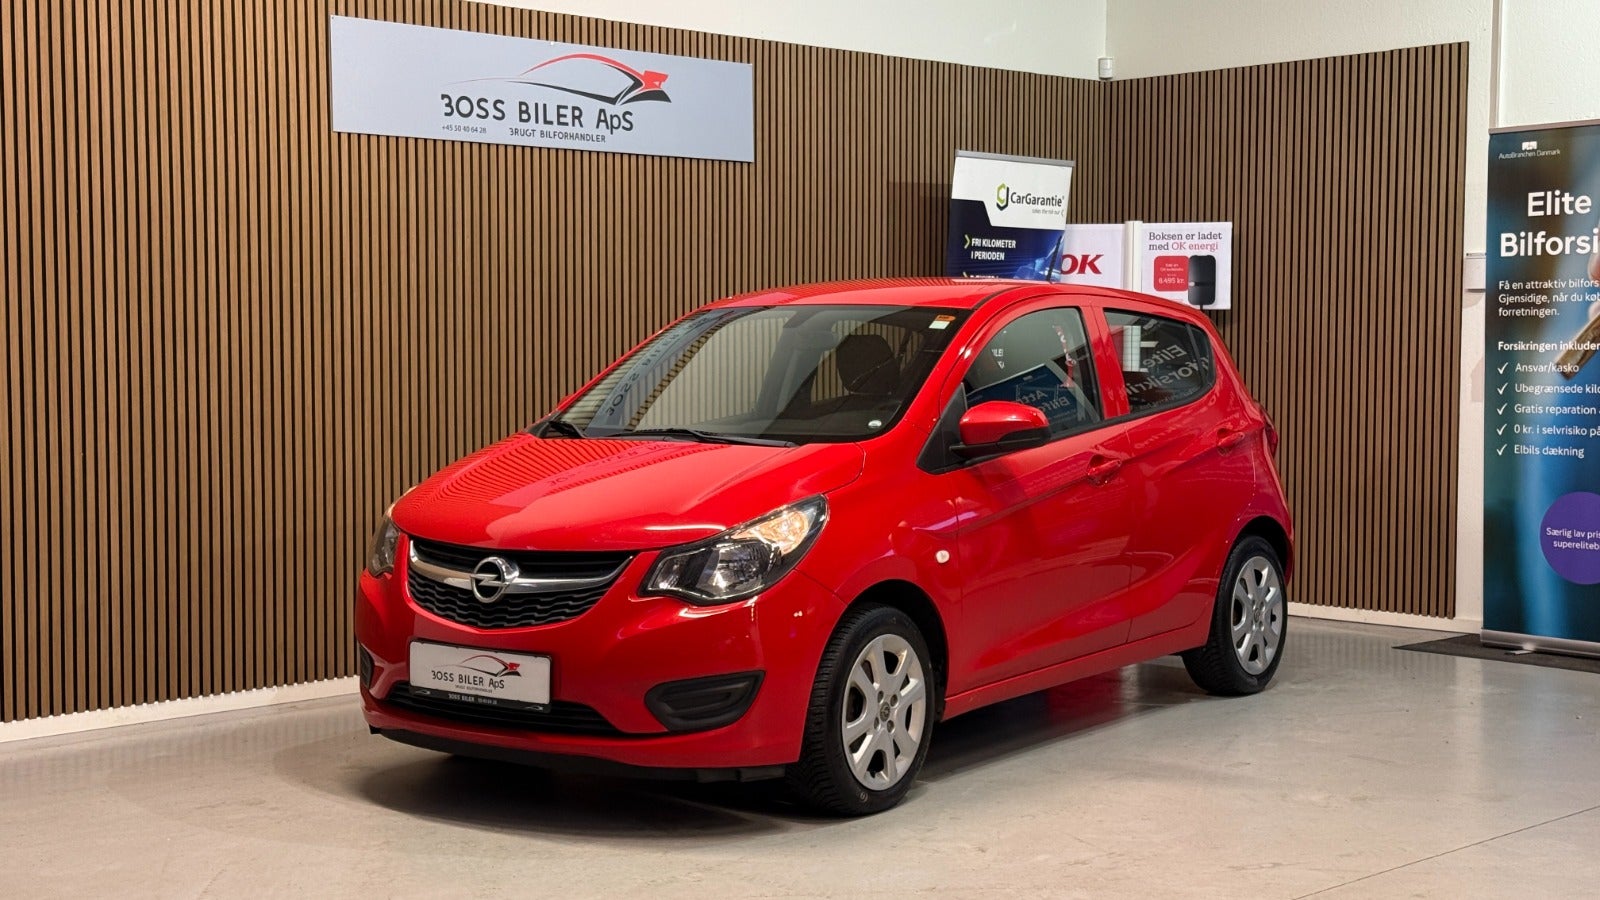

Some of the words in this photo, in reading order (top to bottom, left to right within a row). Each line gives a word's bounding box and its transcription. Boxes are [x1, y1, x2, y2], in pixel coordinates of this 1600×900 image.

[519, 101, 583, 128] BILER
[596, 108, 634, 135] ApS
[540, 130, 606, 143] BILFORHANDLER
[1527, 189, 1592, 217] Elite
[1148, 231, 1183, 241] Boksen
[1198, 231, 1222, 240] ladet
[1500, 227, 1599, 257] Bilforsi
[971, 238, 982, 247] FRI
[982, 239, 1016, 249] KILOMETER
[1148, 241, 1169, 250] med
[1171, 242, 1187, 250] OK
[1188, 242, 1219, 252] energi
[974, 251, 1005, 260] PERIODEN
[1060, 254, 1104, 275] OK
[1499, 280, 1510, 290] Få
[1525, 280, 1567, 289] attraktiv
[1498, 294, 1550, 305] Gjensidige,
[1552, 292, 1568, 302] når
[1570, 293, 1582, 301] du
[1498, 306, 1560, 318] forretningen.
[1498, 341, 1557, 352] Forsikringen
[1515, 362, 1580, 373] Ansvar/kasko
[1514, 383, 1583, 395] Ubegrænsede
[1514, 403, 1543, 413] Gratis
[1545, 405, 1597, 416] reparation
[1513, 424, 1521, 434] 0
[1522, 424, 1535, 434] kr.
[1542, 425, 1587, 436] selvrisiko
[1513, 444, 1540, 455] Elbils
[1542, 446, 1585, 459] dækning
[1546, 527, 1572, 538] Særlig
[1573, 529, 1586, 537] lav
[458, 674, 484, 686] BILER
[488, 678, 505, 690] ApS
